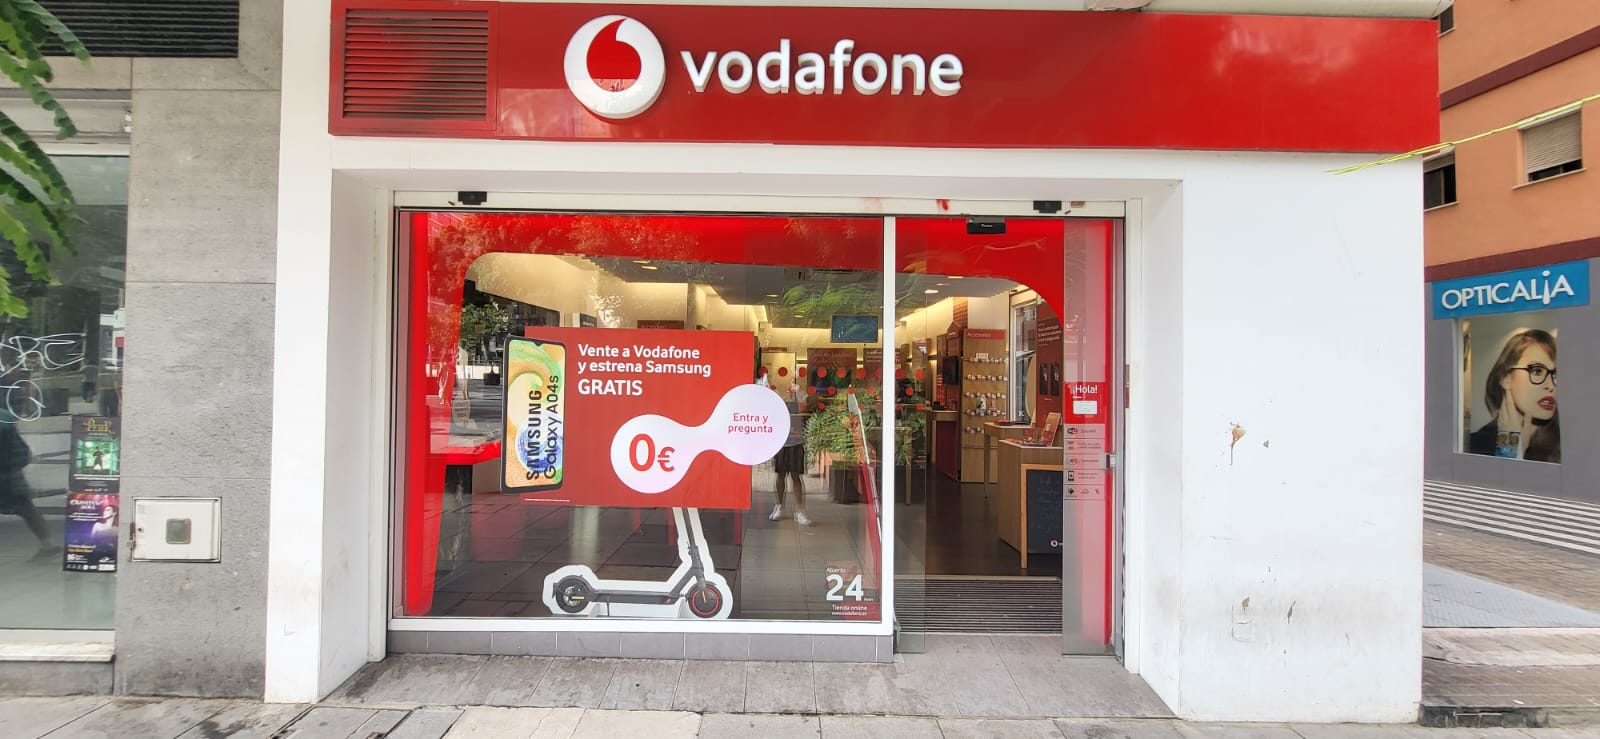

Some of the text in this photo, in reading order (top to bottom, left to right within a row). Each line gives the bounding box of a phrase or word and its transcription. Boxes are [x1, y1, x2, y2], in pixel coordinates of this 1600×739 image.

[680, 38, 963, 96] vodafone
[577, 343, 701, 359] Vente a Vodafone
[577, 360, 711, 378] y estrena Samsung
[577, 378, 643, 396] GRATIS
[1072, 384, 1098, 396] ¡Hola!
[543, 375, 562, 479] Galaxy A04s
[733, 412, 769, 424] Entra y
[526, 390, 542, 480] SAMSUNG
[727, 424, 773, 434] pregunta
[629, 433, 676, 473] 0€
[826, 574, 864, 601] 24
